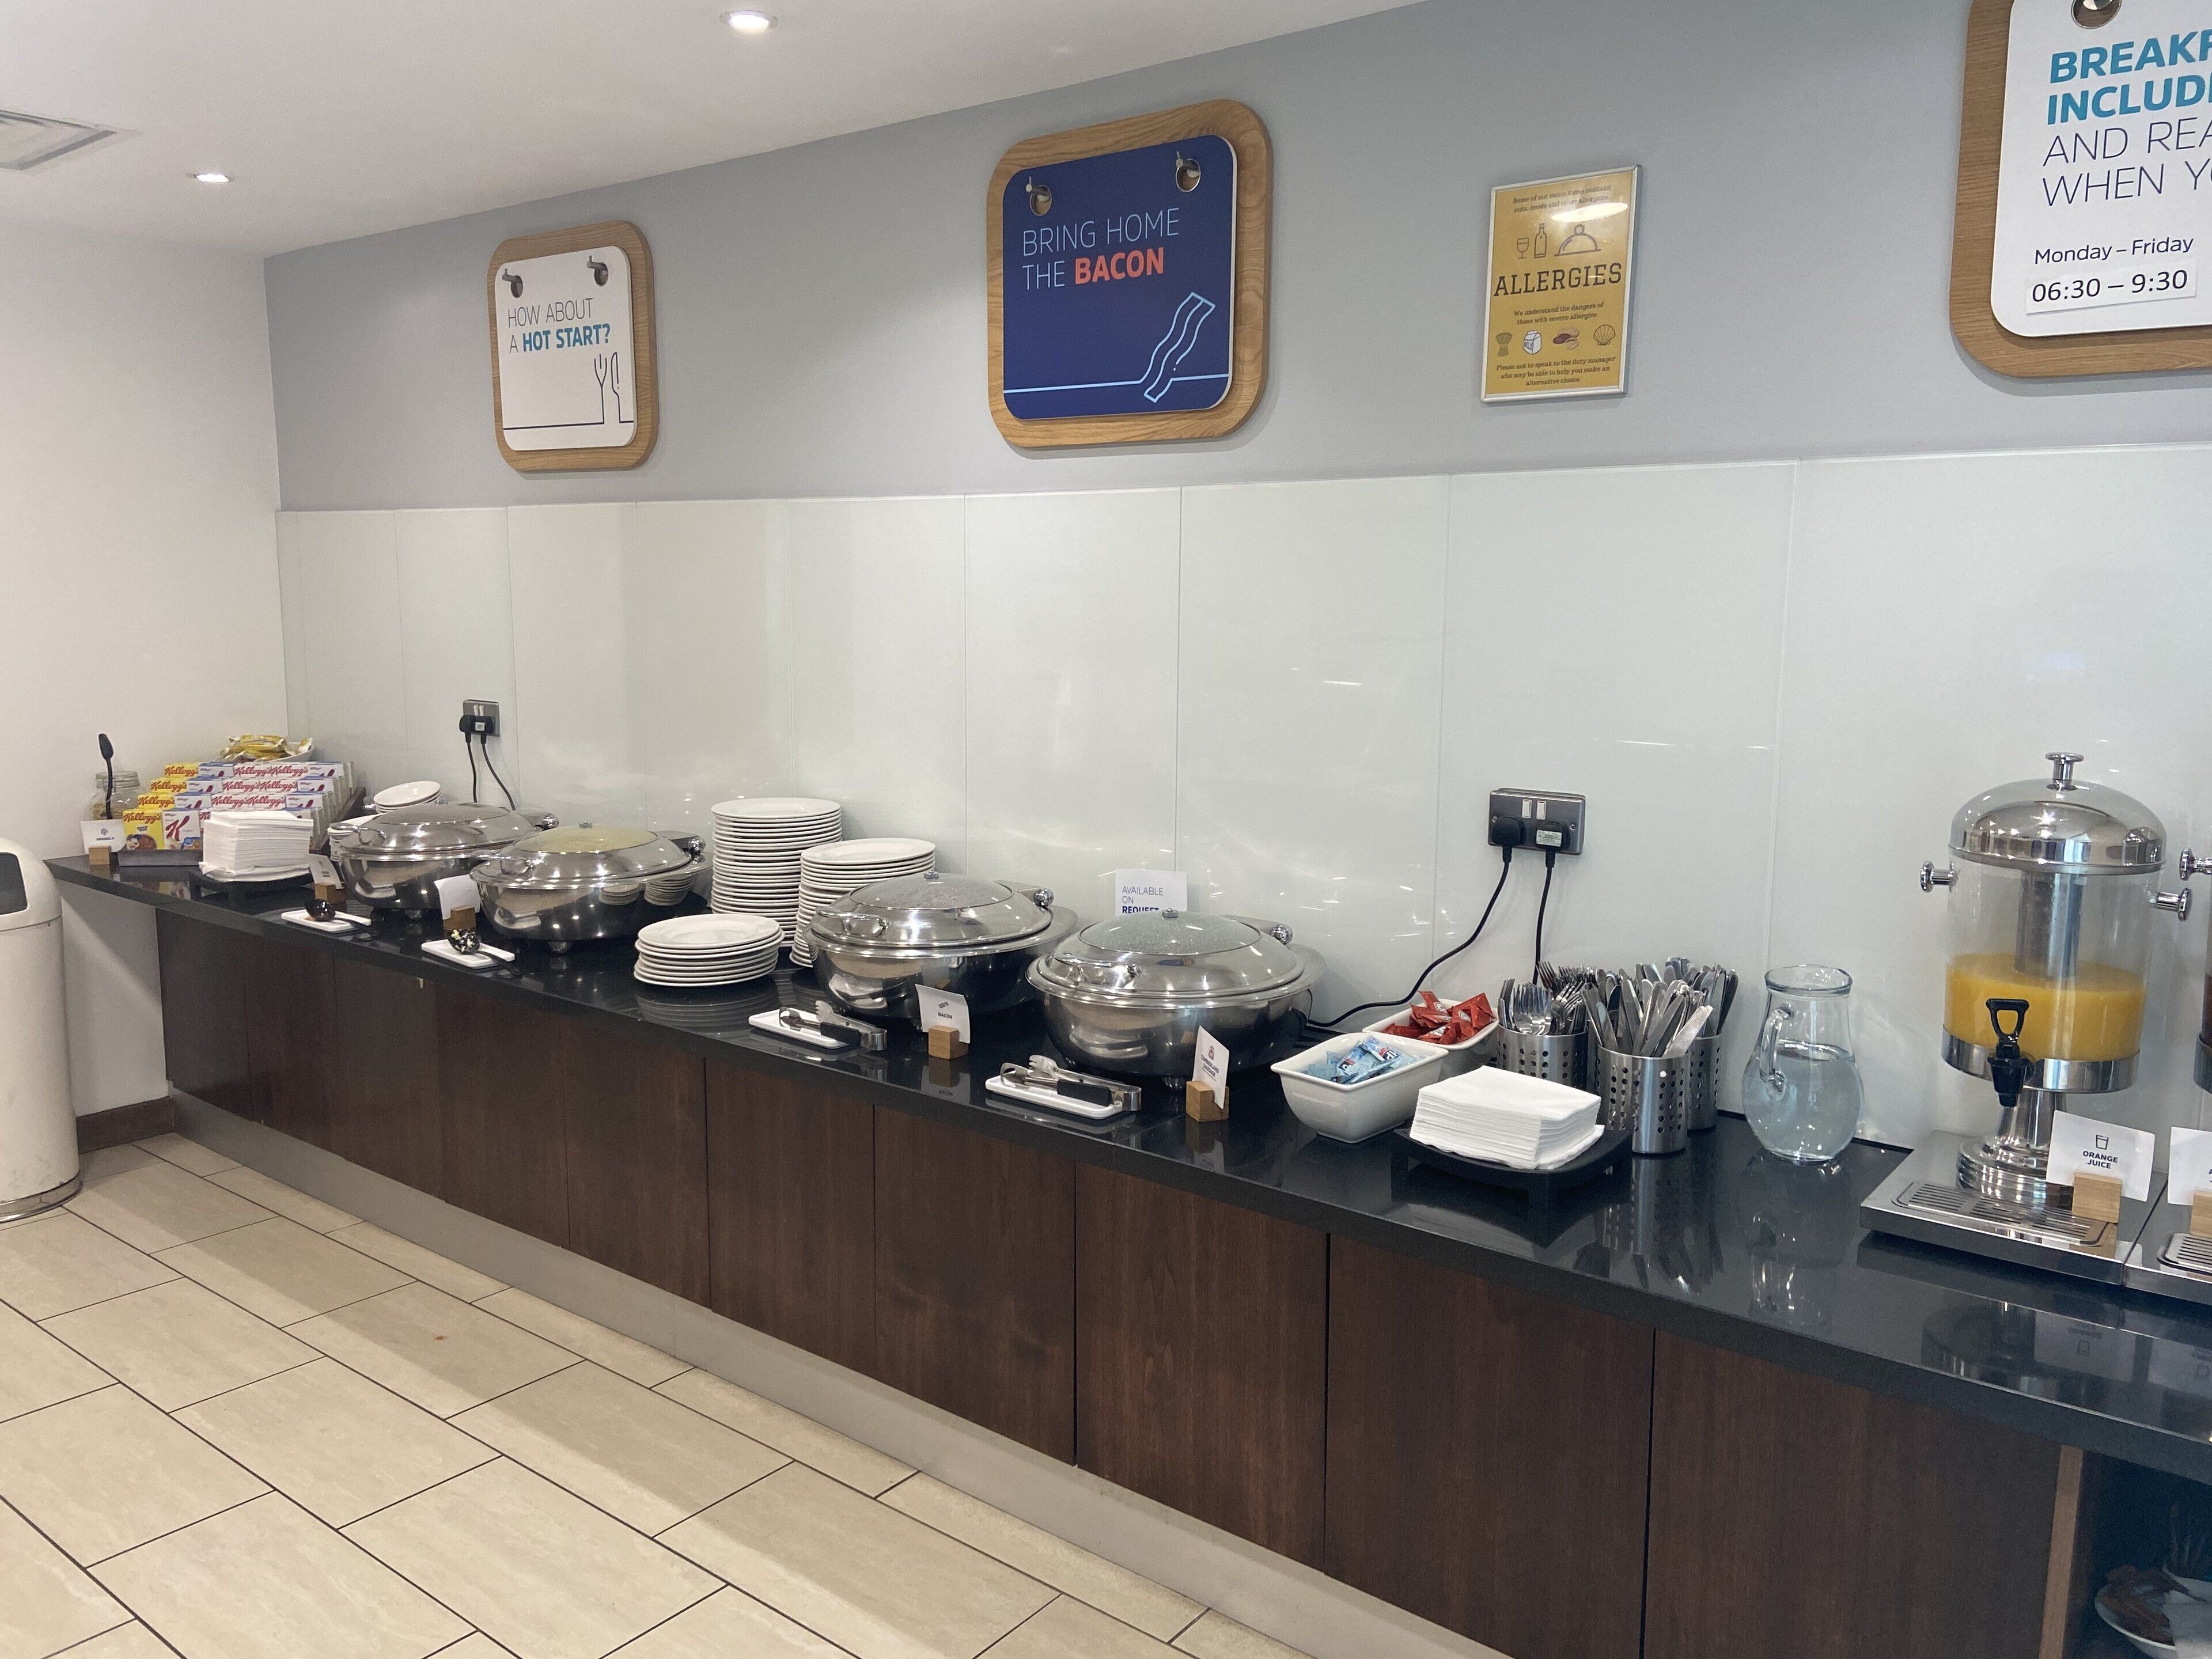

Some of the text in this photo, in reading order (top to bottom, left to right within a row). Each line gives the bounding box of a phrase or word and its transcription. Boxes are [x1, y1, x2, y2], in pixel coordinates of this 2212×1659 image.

[2047, 73, 2212, 126] INCLUD
[2043, 127, 2129, 166] AND
[2042, 162, 2165, 207] WHEN
[1023, 207, 1180, 256] BRING HOME
[2035, 243, 2112, 264] Monday
[2131, 236, 2194, 256] Friday
[1022, 247, 1164, 290] THE BACON
[1494, 262, 1622, 296] ALLERGIES
[2032, 278, 2100, 303] 06:30
[2132, 269, 2188, 294] 9:30
[507, 298, 593, 328] HOW ABOUT
[1525, 306, 1559, 316] understand
[510, 323, 611, 354] A HOT START?
[1588, 357, 1616, 365] manager
[1526, 378, 1559, 386] alternative
[271, 765, 308, 777] Kellogg's
[151, 781, 187, 792] Kellogg's
[138, 796, 175, 808] Kellogg's
[123, 812, 161, 824] Kellogg's
[1122, 886, 1164, 896] AVAILABLE
[1122, 896, 1134, 904] ON
[2083, 1150, 2118, 1163] ORANGE
[2087, 1159, 2111, 1169] JUICE
